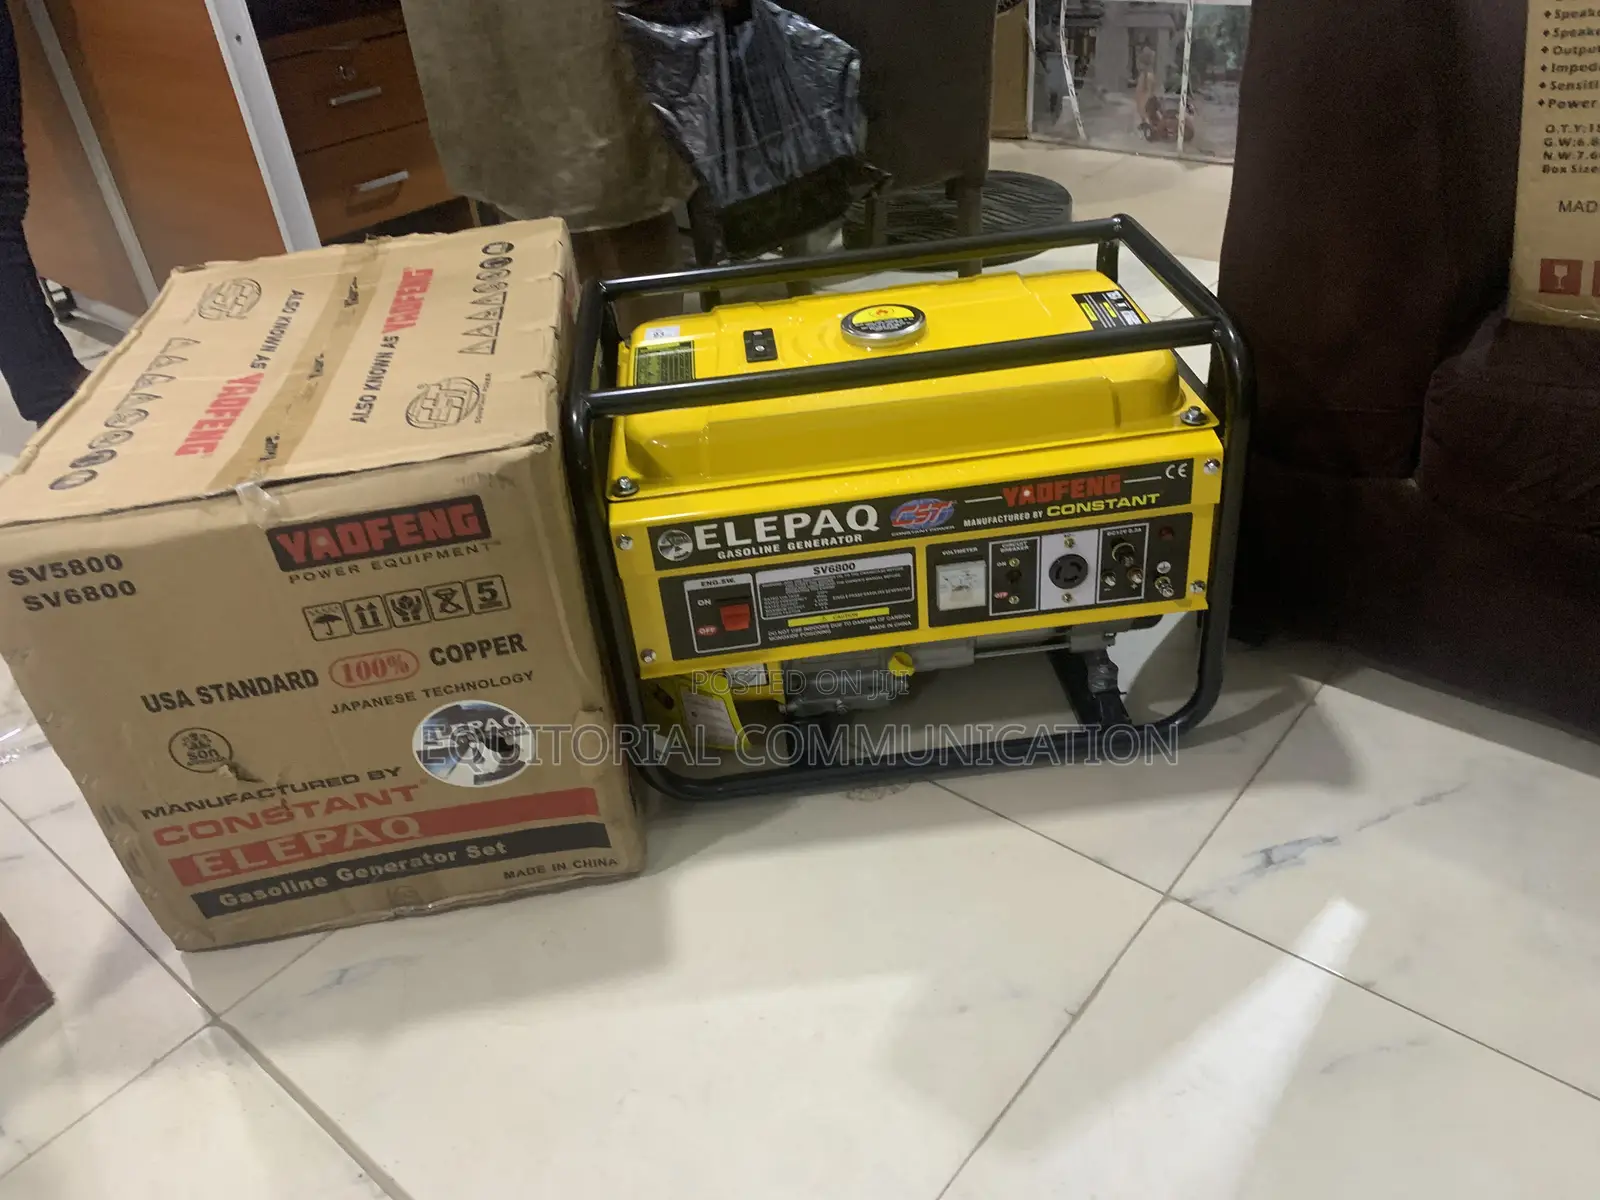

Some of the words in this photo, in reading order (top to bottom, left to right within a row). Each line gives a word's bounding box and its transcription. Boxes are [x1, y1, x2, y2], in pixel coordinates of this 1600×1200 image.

[1551, 63, 1600, 76] Imped
[1548, 98, 1597, 109] Power
[1542, 164, 1567, 174] Box
[282, 288, 305, 315] ALSO
[259, 315, 293, 353] KNOWN
[250, 354, 271, 370] AS
[349, 394, 377, 424] ALSO
[363, 352, 394, 391] KNOWN
[380, 335, 400, 349] AS
[1002, 474, 1121, 507] YAOFENG
[963, 513, 1032, 528] MANUFACTURED
[1032, 510, 1043, 520] BY
[1046, 493, 1161, 518] CONSTANT
[276, 503, 483, 565] YAOFENG
[694, 504, 880, 551] ELEPAQ
[717, 543, 780, 560] GASOLINE
[787, 533, 863, 552] GENERATOR
[8, 553, 124, 586] SV5800
[288, 563, 361, 585] POWER
[371, 544, 492, 571] EQUIPMENT
[813, 562, 856, 575] SV6800
[22, 580, 138, 612] SV6800
[476, 582, 499, 604] 5
[697, 599, 712, 607] ON
[140, 691, 196, 714] USA
[195, 668, 320, 706] STANDARD
[341, 653, 411, 684] 100%
[429, 632, 528, 667] COPPER
[330, 690, 417, 715] JAPANESE
[421, 670, 534, 700] TECHNOLOGY
[141, 773, 360, 820] MANUFACTURED
[366, 766, 402, 781] BY
[152, 784, 420, 848] CONSTANT
[194, 815, 421, 880] ELEPAQ
[219, 874, 329, 908] Gasoline
[336, 847, 458, 883] Generator
[467, 841, 509, 859] Set
[502, 866, 545, 880] MADE
[551, 862, 566, 874] IN
[571, 856, 618, 871] CHINA
